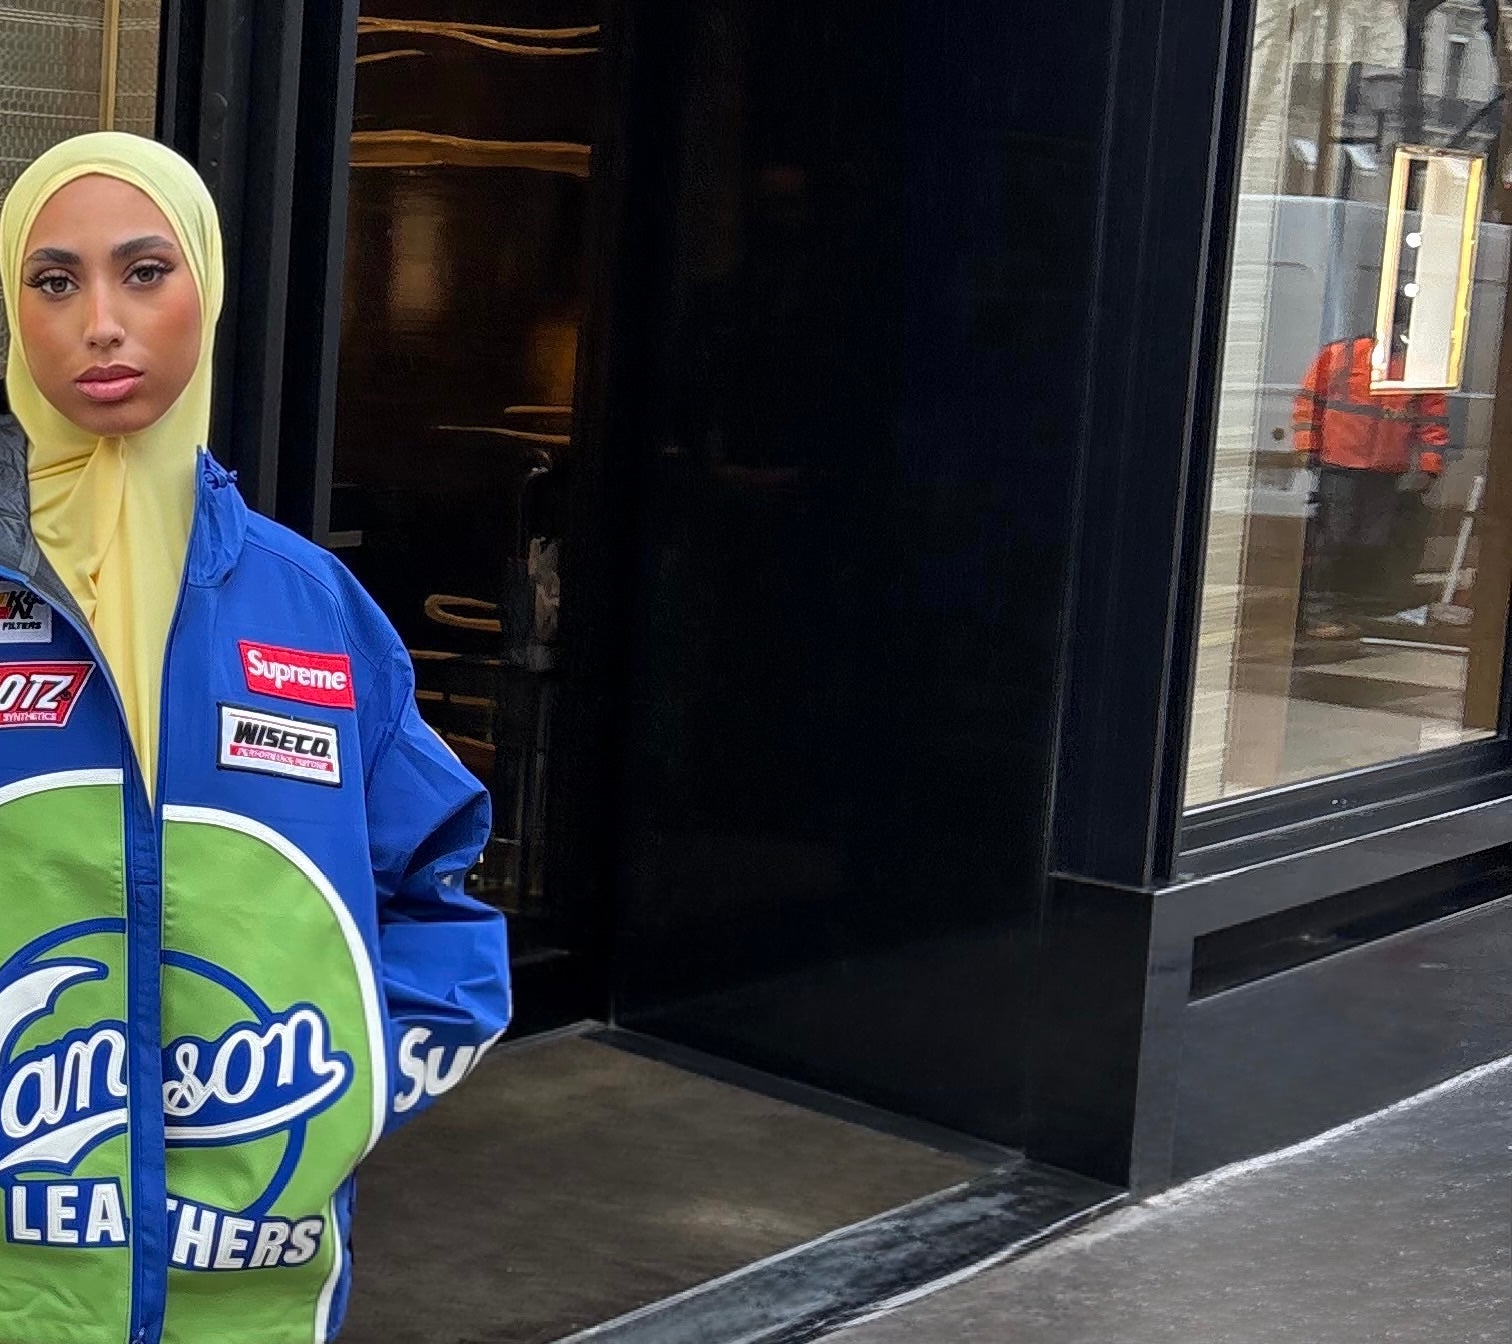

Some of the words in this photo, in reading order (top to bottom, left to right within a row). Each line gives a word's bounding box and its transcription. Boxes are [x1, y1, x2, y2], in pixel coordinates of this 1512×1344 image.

[2, 621, 43, 631] FILTERS
[247, 649, 347, 691] Supreme
[2, 712, 57, 722] SYNTHETICS
[393, 1027, 507, 1113] Su
[11, 1182, 324, 1270] LEAHERS
